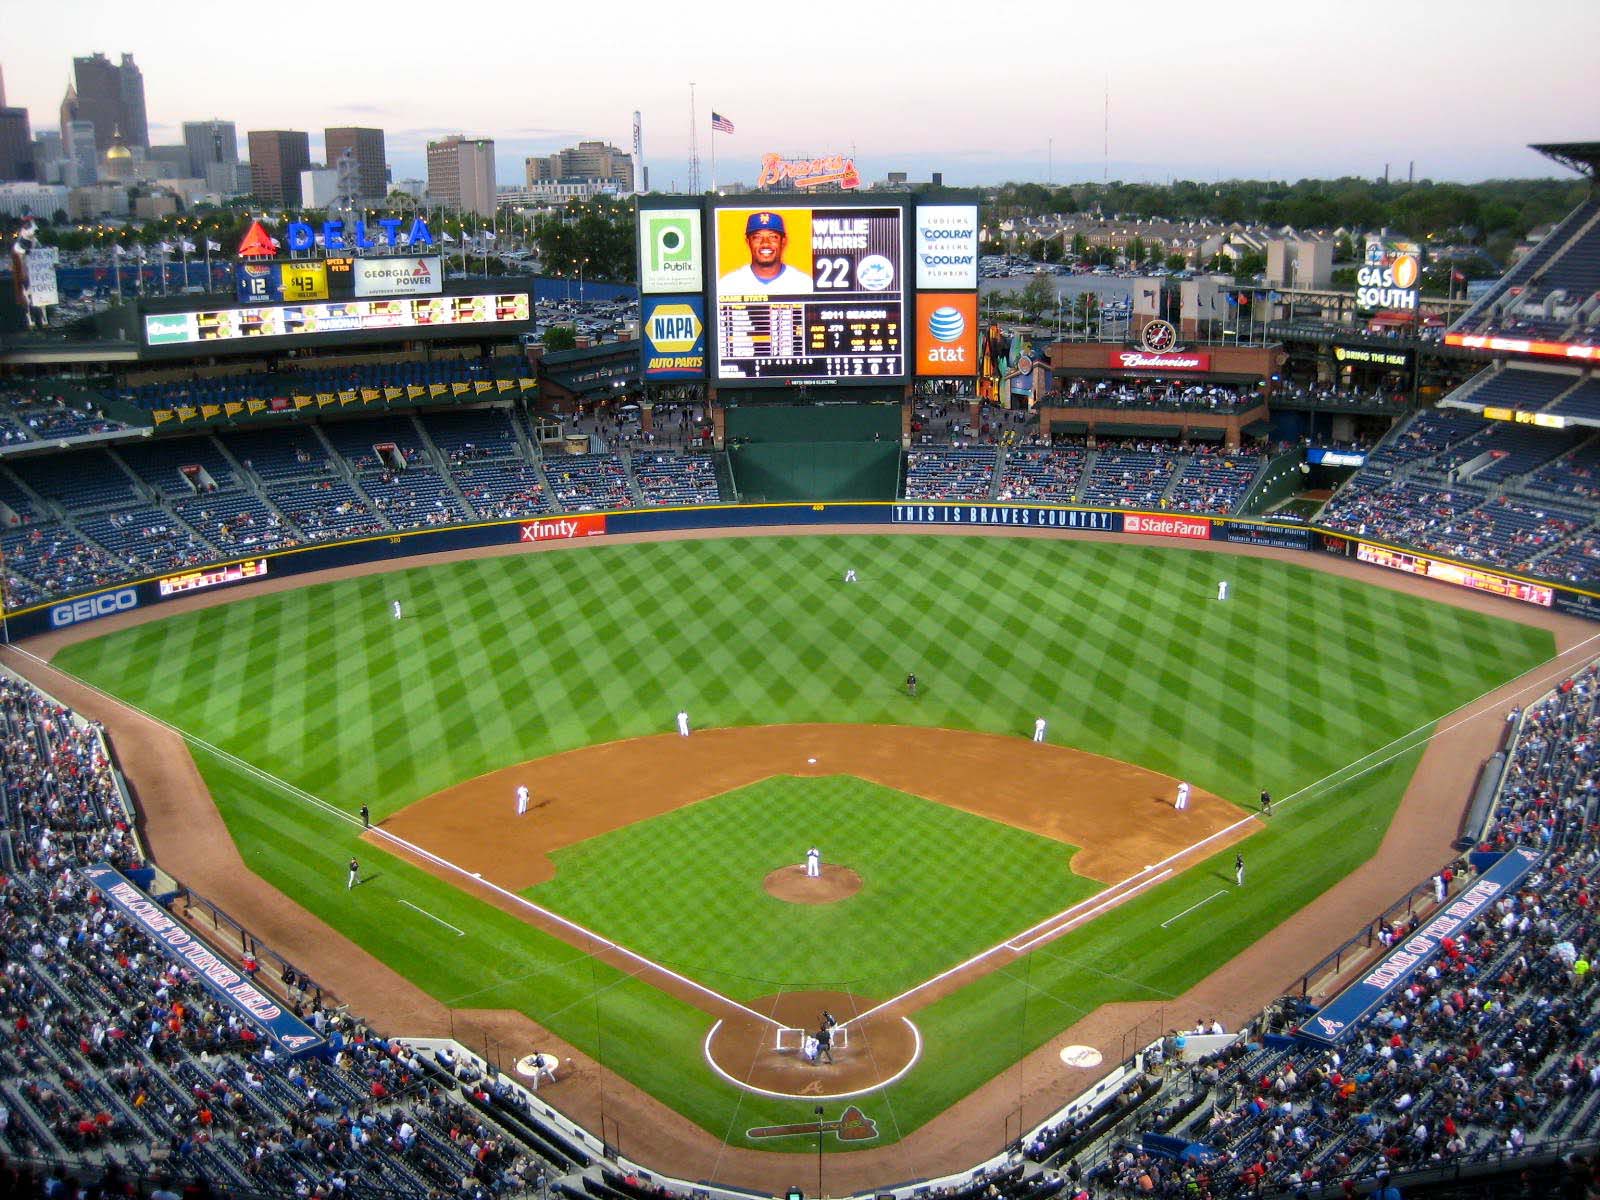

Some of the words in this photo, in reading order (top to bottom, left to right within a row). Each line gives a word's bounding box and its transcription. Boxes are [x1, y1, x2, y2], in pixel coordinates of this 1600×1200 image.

[758, 153, 843, 188] Braves
[812, 219, 869, 234] WILLIE
[925, 229, 972, 239] COOLRAY
[288, 219, 433, 250] DELTA
[812, 236, 867, 249] HARRIS
[663, 262, 692, 271] Publix
[925, 255, 972, 265] COOLRAY
[364, 269, 411, 278] GEORGIA
[816, 258, 849, 288] 22
[1357, 267, 1393, 288] GAS
[396, 277, 431, 285] POWER
[1356, 287, 1416, 309] SOUTH
[821, 311, 843, 319] 2011
[655, 317, 693, 339] NAPA
[928, 346, 965, 362] at&t
[1120, 354, 1199, 367] Budweiser
[1346, 350, 1370, 361] BRING
[1371, 353, 1385, 363] THE
[1386, 355, 1406, 365] HEAT
[648, 358, 673, 369] AUTO
[674, 356, 703, 368] PARTS
[854, 364, 862, 374] 2
[870, 364, 879, 375] 0
[887, 364, 894, 374] 1
[896, 506, 934, 521] THIS
[944, 507, 960, 522] IS
[970, 508, 1029, 524] BRAVES
[1039, 510, 1108, 528] COUNTRY
[522, 519, 578, 541] xfinity
[53, 589, 137, 626] GEICO
[1362, 952, 1420, 990] HOME
[1405, 936, 1436, 954] OF
[1421, 916, 1462, 940] THE
[1445, 880, 1501, 919] BRAVES
[107, 882, 176, 932] WELCOME
[160, 926, 191, 945] TO
[177, 940, 241, 987] TURNER
[225, 981, 281, 1020] FIELD
